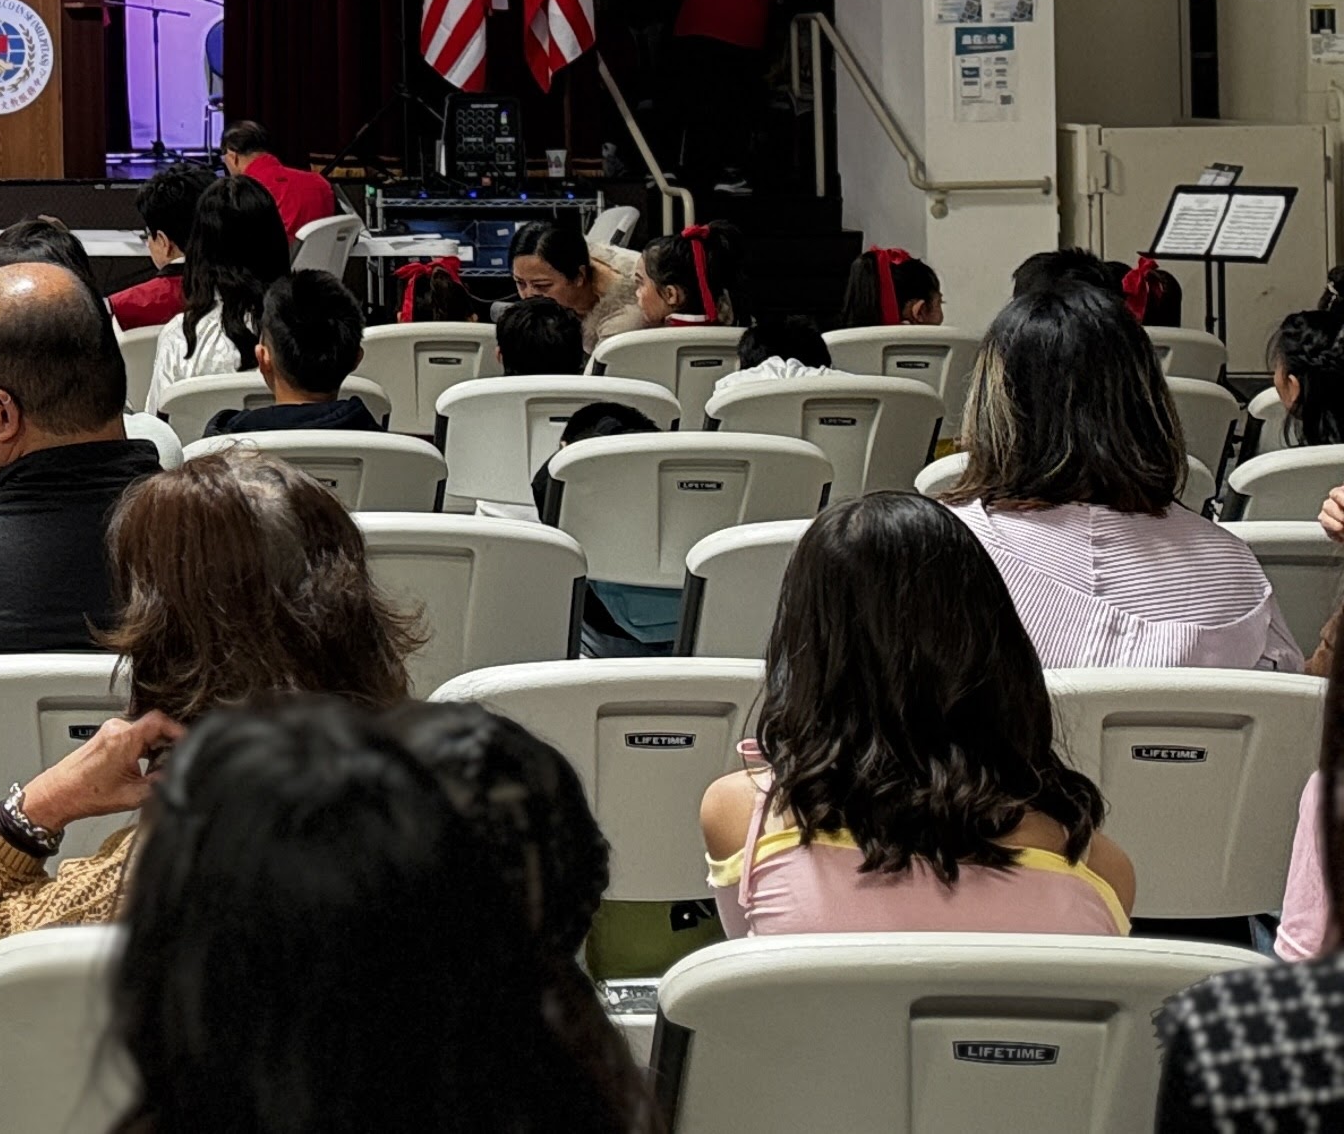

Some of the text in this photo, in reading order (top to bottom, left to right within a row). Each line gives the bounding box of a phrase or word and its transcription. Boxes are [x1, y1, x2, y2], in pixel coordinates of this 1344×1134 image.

[635, 736, 687, 745] LIFETIME
[1142, 749, 1199, 759] LIFETIME
[968, 1046, 1046, 1060] LIFETIME
